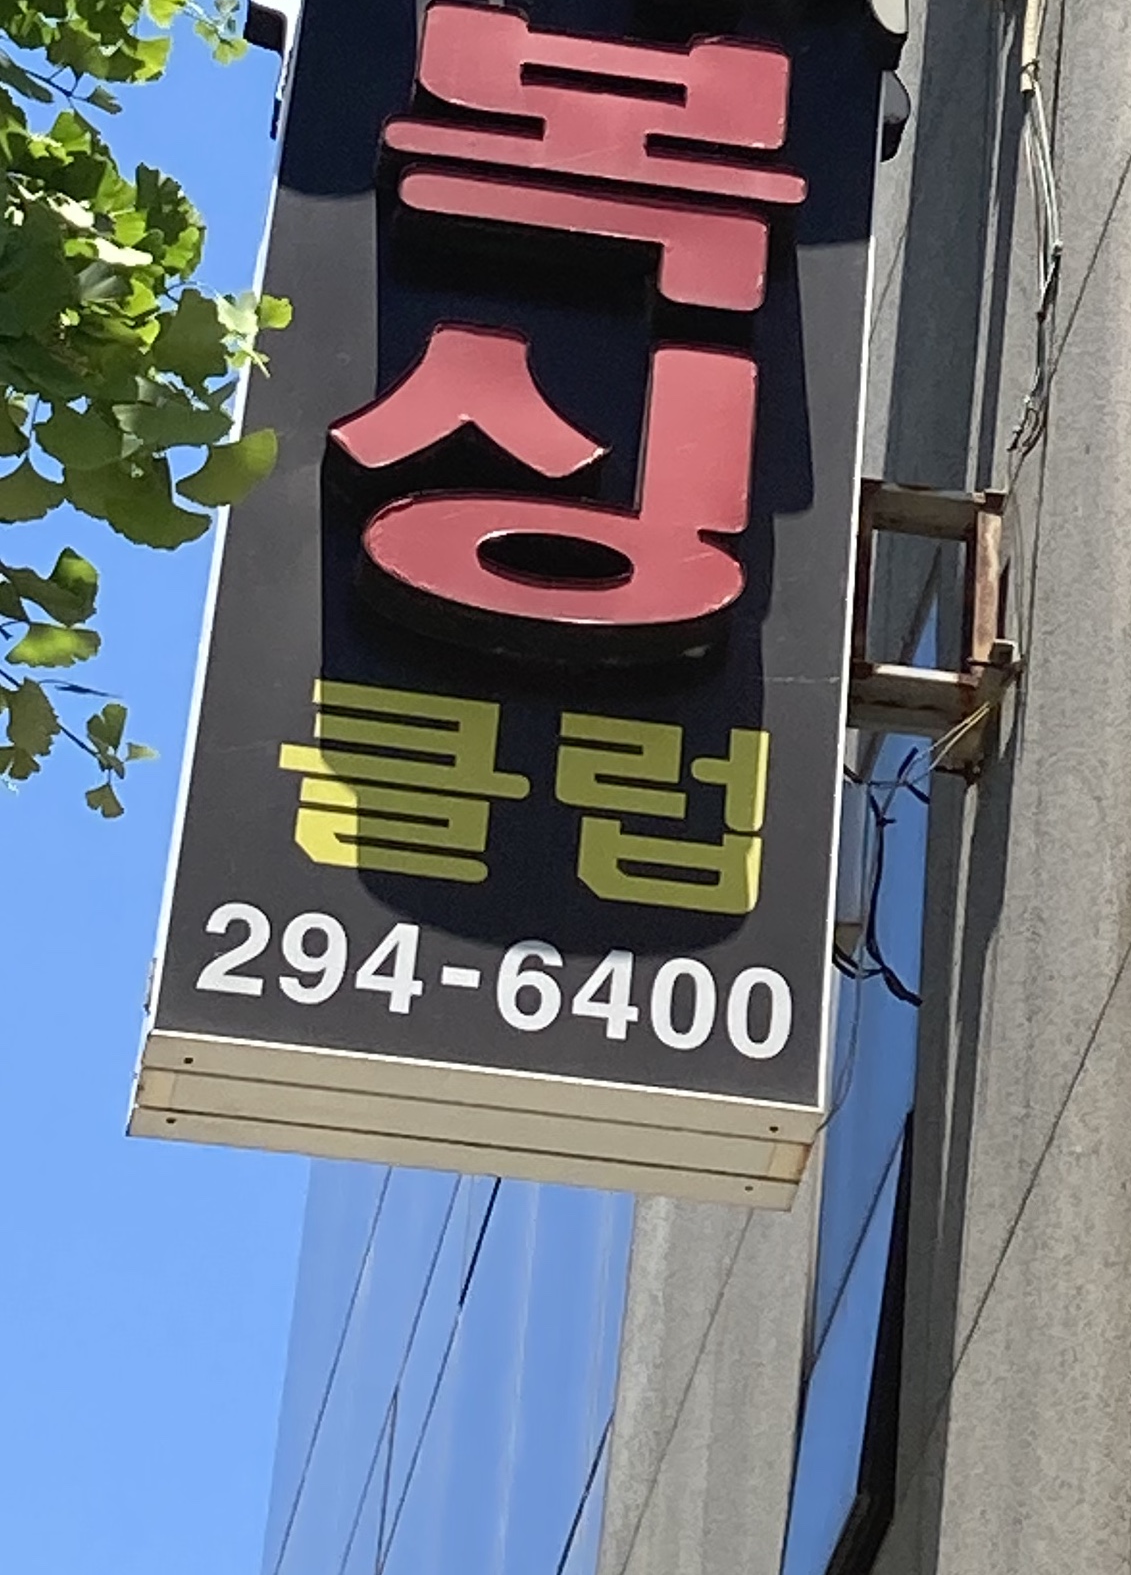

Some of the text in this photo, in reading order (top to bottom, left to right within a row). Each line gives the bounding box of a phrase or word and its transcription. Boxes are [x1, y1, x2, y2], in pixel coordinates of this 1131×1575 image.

[328, 0, 808, 625] 복싱
[278, 679, 771, 915] 클럽
[196, 902, 794, 1060] 294-6400
